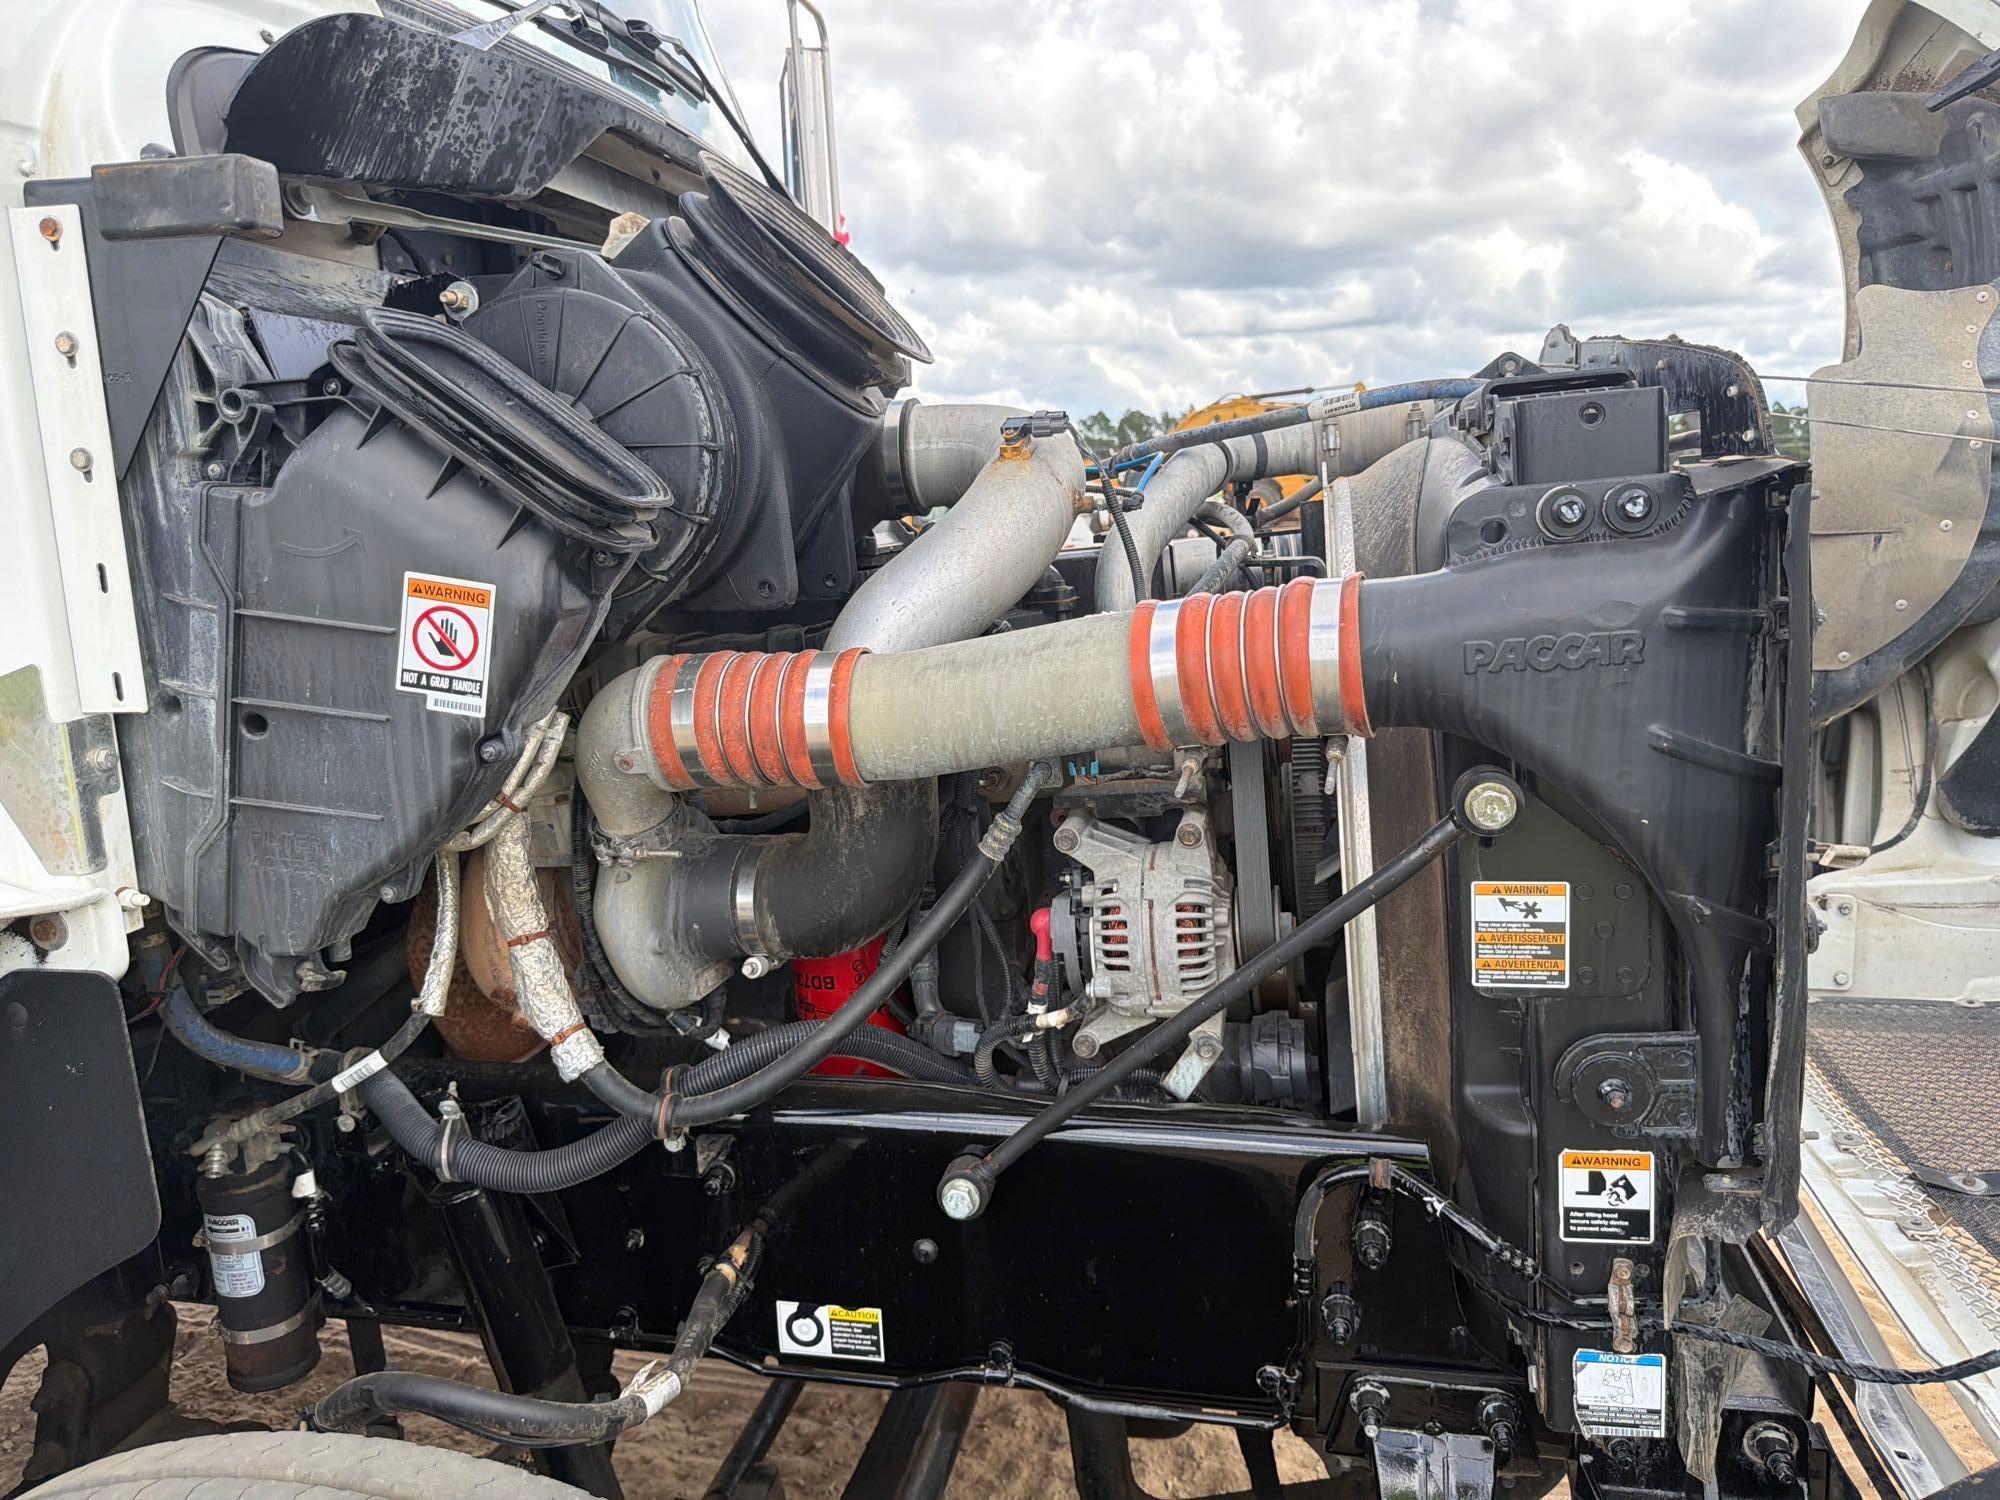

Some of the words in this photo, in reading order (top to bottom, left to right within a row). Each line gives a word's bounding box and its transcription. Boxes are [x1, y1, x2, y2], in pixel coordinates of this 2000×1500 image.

[424, 586, 486, 603] WARNING
[1464, 630, 1645, 675] PACCAR
[403, 672, 418, 684] NOT
[421, 674, 427, 686] A
[430, 676, 450, 689] GRAB
[452, 679, 481, 694] HANDLE
[1504, 885, 1549, 894] WARNING
[1490, 935, 1563, 943] AVERTISSEMENT
[1495, 961, 1559, 969] ADVERTENCIA
[1582, 1157, 1641, 1167] WARNING
[838, 1310, 878, 1320] CAUTION
[1599, 1354, 1638, 1364] NOTICE
